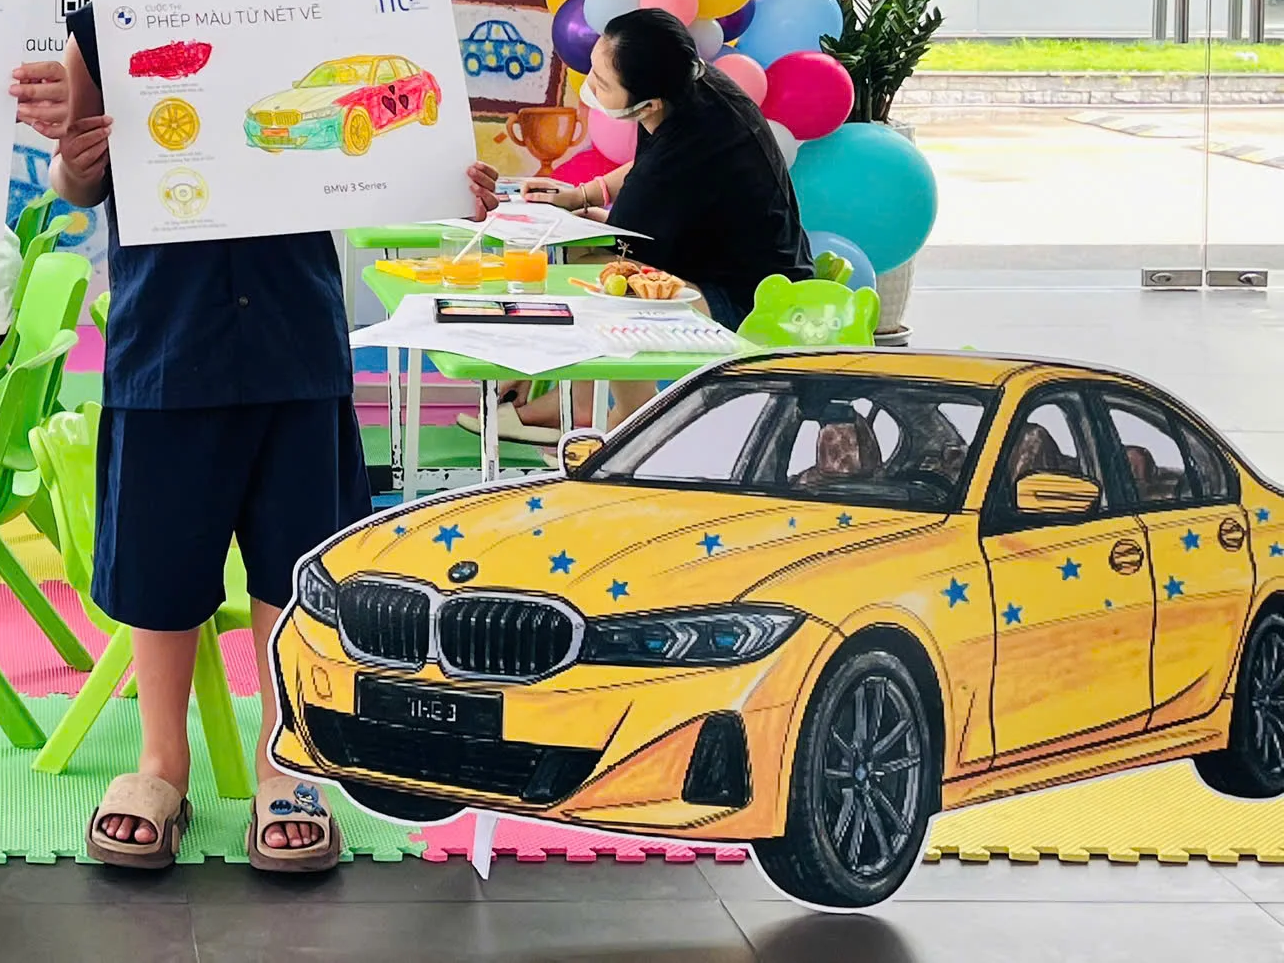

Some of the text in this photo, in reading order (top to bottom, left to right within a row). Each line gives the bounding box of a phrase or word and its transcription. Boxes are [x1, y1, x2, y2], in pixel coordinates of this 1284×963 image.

[146, 11, 191, 29] PHÉP
[195, 10, 232, 26] MÀU
[323, 181, 388, 195] BMW 3 Series
